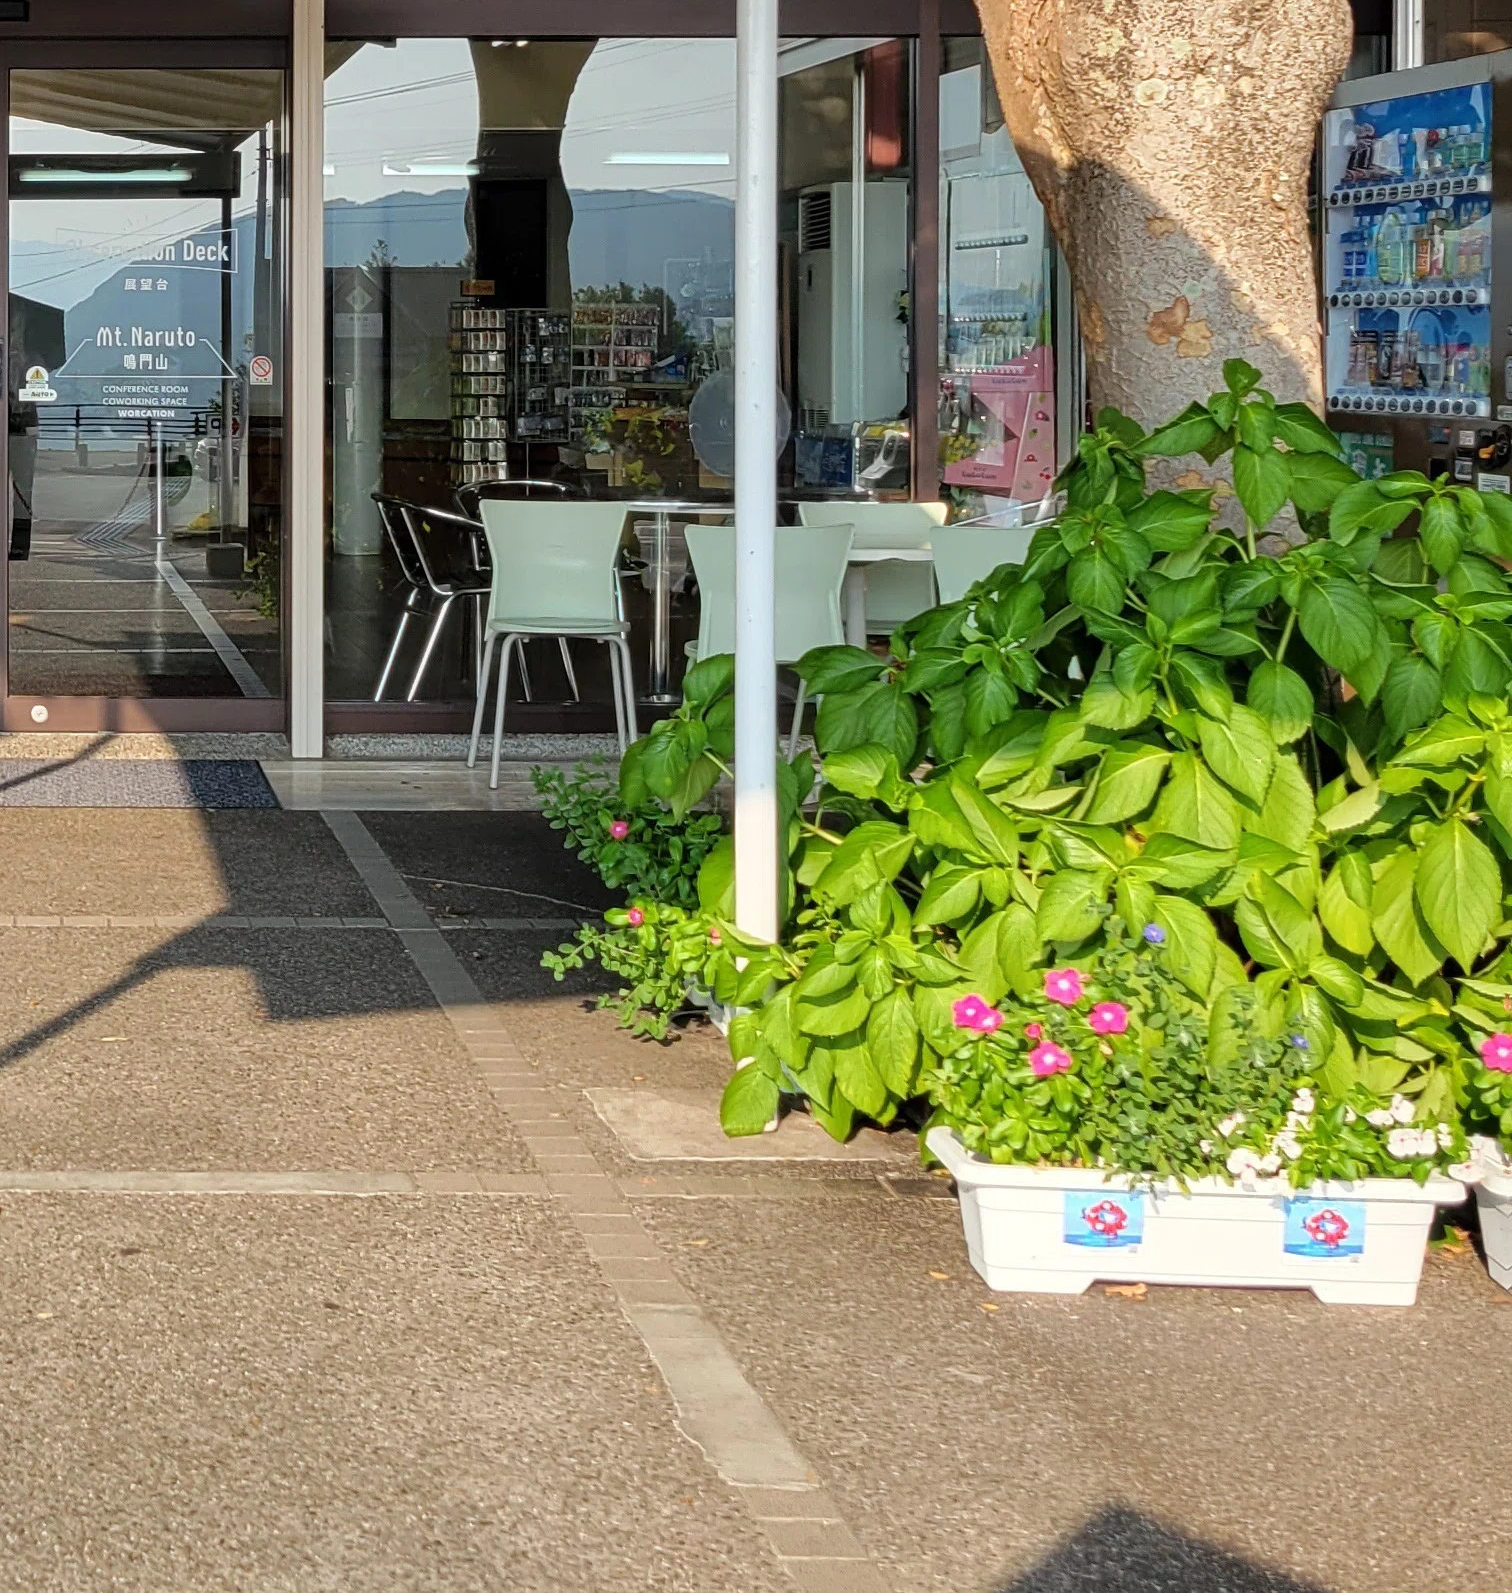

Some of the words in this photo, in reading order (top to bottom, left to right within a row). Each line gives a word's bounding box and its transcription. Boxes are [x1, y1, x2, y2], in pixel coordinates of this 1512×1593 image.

[183, 240, 230, 262] Deck
[102, 385, 159, 394] CONFERENCE
[161, 385, 189, 394] ROOM
[102, 397, 159, 406] COWORKING
[161, 397, 188, 406] SPACE
[118, 409, 175, 418] WORCATION
